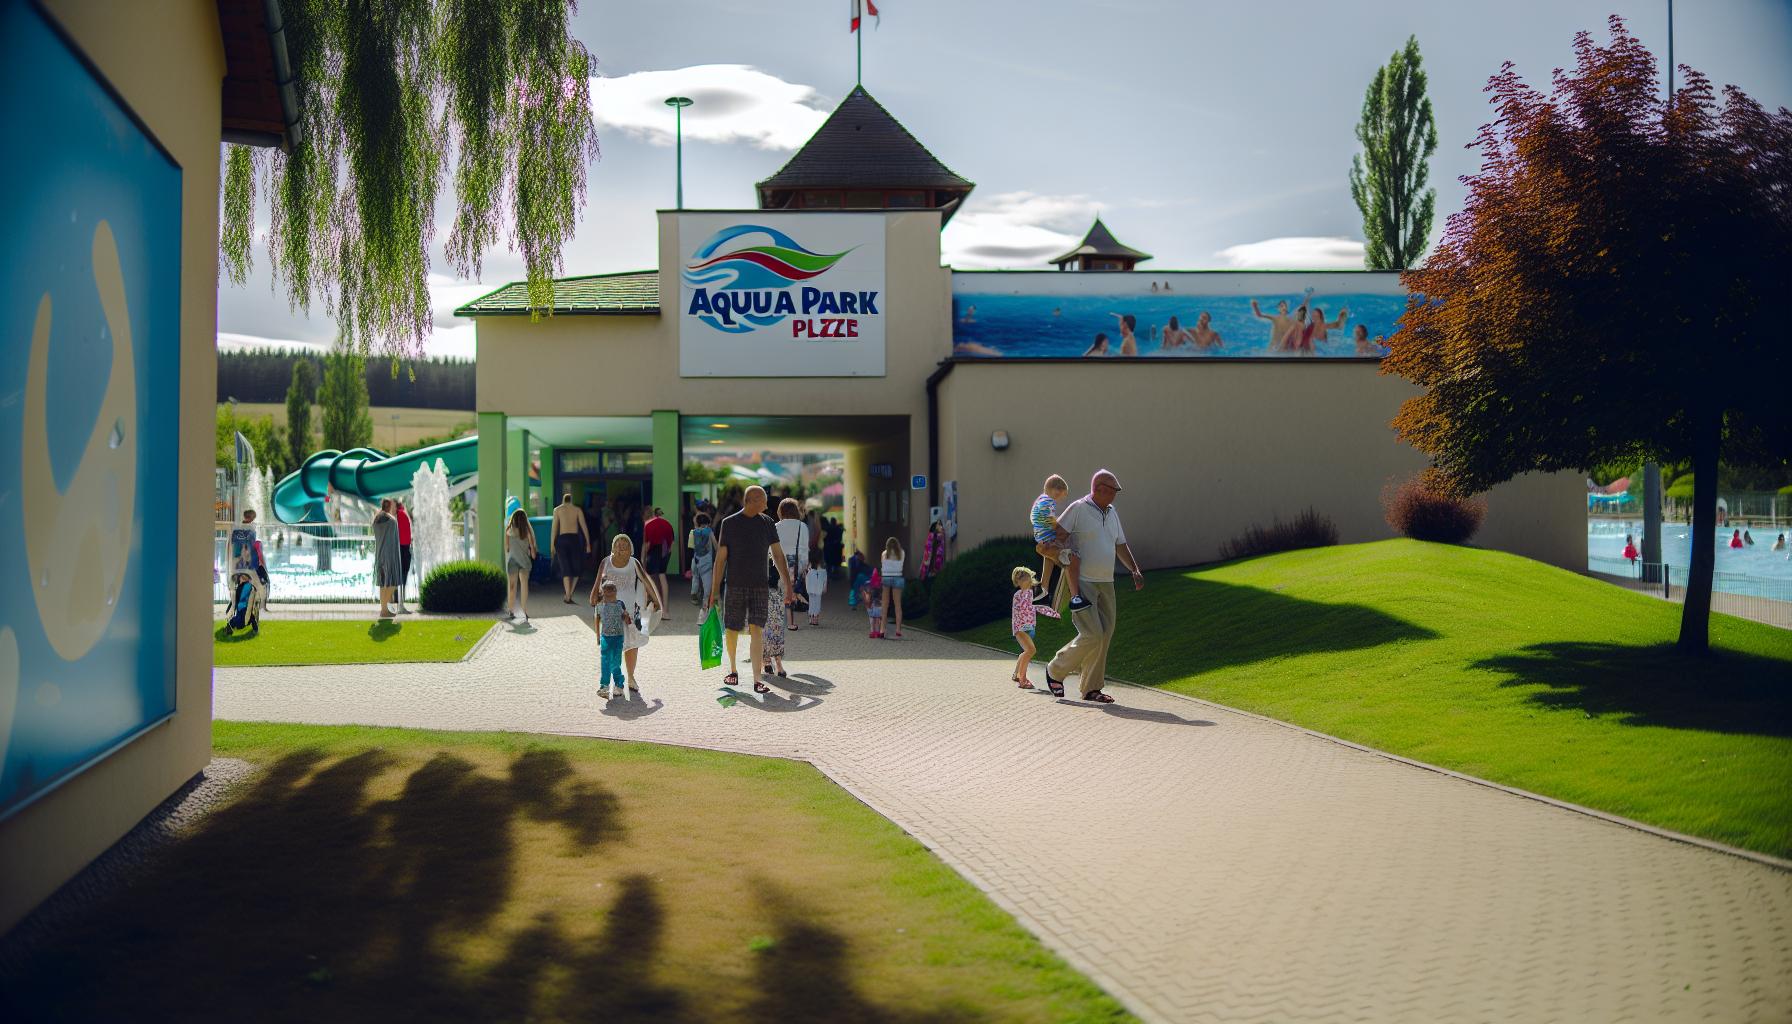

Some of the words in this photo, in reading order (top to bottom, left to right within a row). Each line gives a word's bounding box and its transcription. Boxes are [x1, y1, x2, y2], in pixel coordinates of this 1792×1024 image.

[688, 287, 796, 325] AQUUA
[802, 286, 878, 314] PARK
[792, 318, 859, 338] PLZZE
